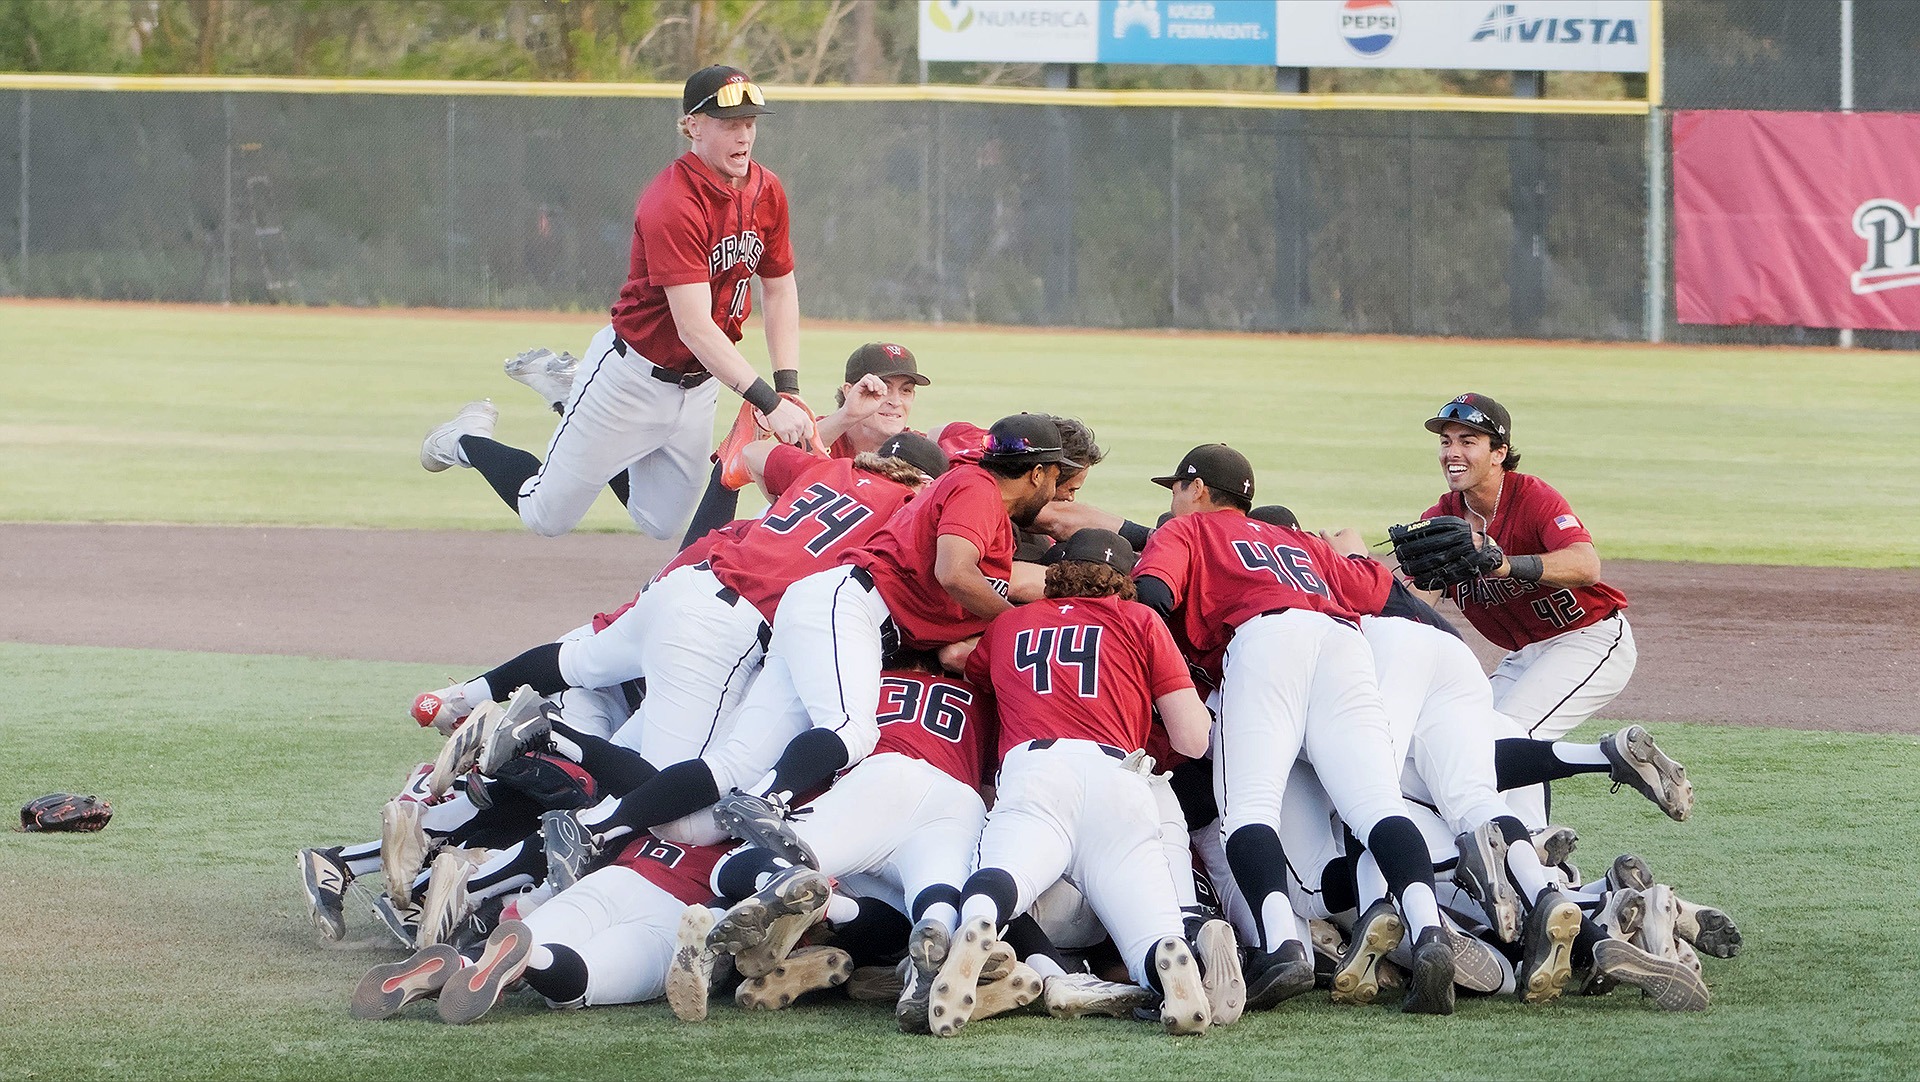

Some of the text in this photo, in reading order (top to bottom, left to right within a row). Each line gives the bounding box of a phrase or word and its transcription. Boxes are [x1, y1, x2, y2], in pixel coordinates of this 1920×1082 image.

[977, 10, 1088, 28] NUMERICA
[1342, 15, 1397, 30] PEPSI
[1470, 4, 1638, 45] AVISTA
[760, 482, 874, 559] 34
[1406, 519, 1431, 532] A2000
[1231, 540, 1331, 601] 46
[1531, 588, 1586, 629] 42
[1013, 624, 1103, 699] 44
[876, 676, 974, 743] 36
